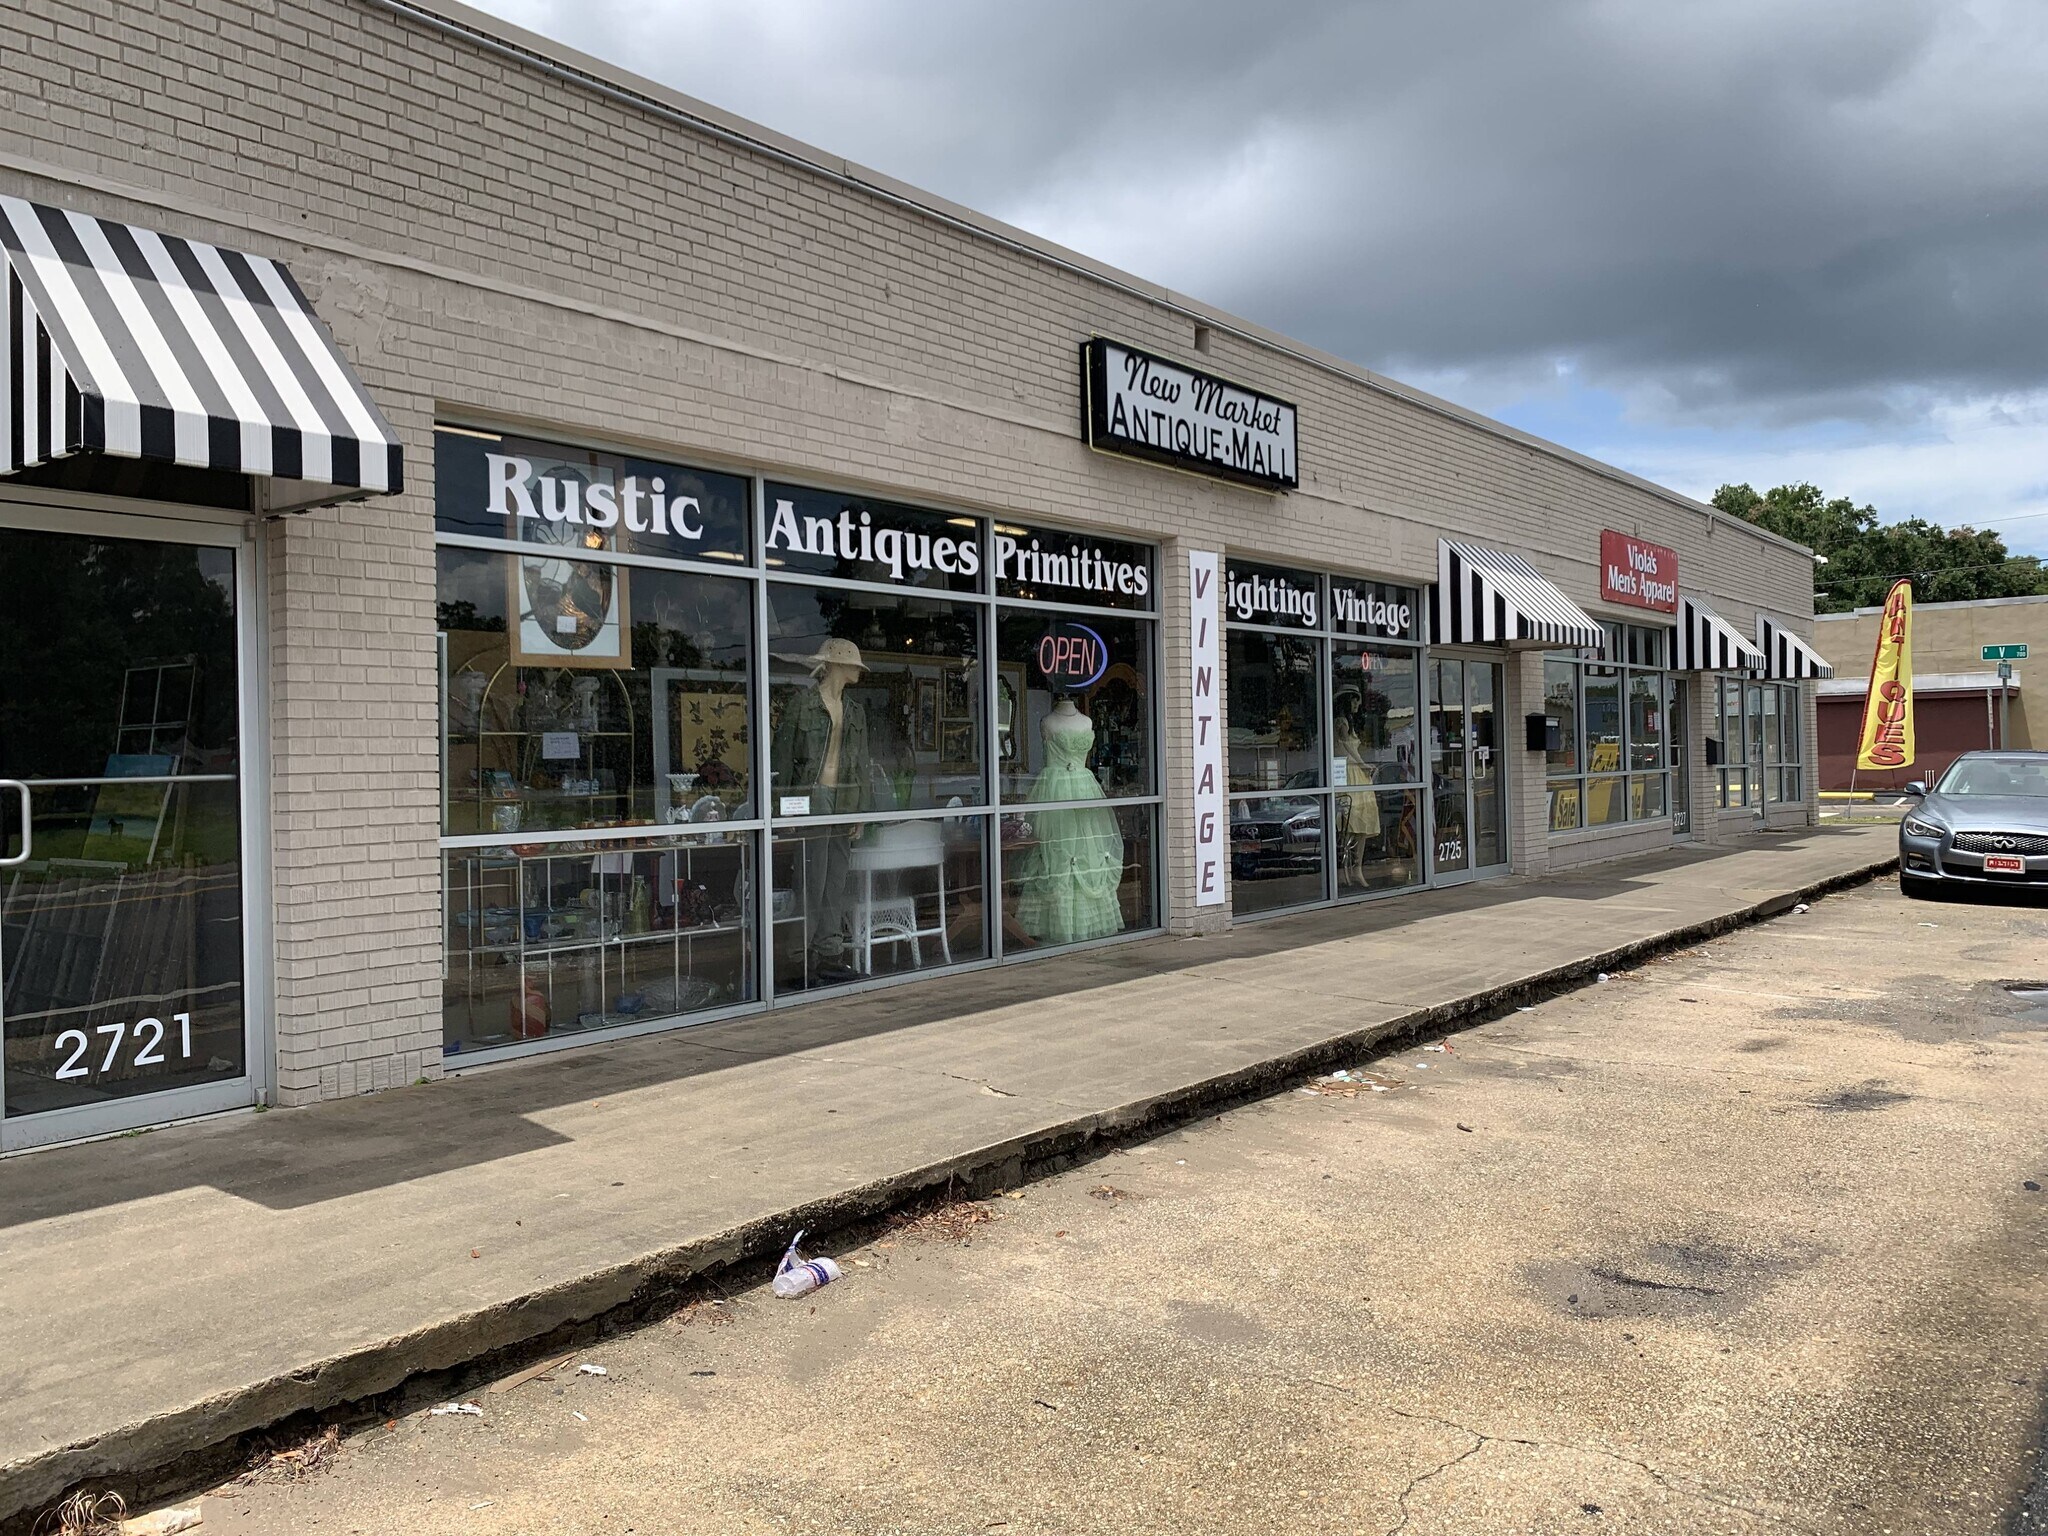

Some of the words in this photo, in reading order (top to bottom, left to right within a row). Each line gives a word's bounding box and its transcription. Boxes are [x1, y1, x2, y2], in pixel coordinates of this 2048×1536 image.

[1124, 354, 1181, 404] New
[1191, 375, 1281, 436] Market
[485, 452, 704, 540] Rustic
[765, 499, 979, 579] Antiques
[995, 536, 1149, 596] Primitives
[1225, 570, 1317, 627] ighting
[1333, 588, 1411, 636] Vintage
[1627, 544, 1657, 575] Viola's
[1607, 564, 1637, 595] Men's
[1639, 572, 1675, 605] Apparel
[1039, 635, 1096, 676] OPEN
[1998, 646, 2006, 658] V
[1868, 593, 1907, 766] ANTIQUES
[1195, 567, 1215, 893] VINTAGE
[1673, 811, 1687, 827] 2727
[1438, 840, 1462, 862] 2725
[54, 1012, 193, 1081] 2721
